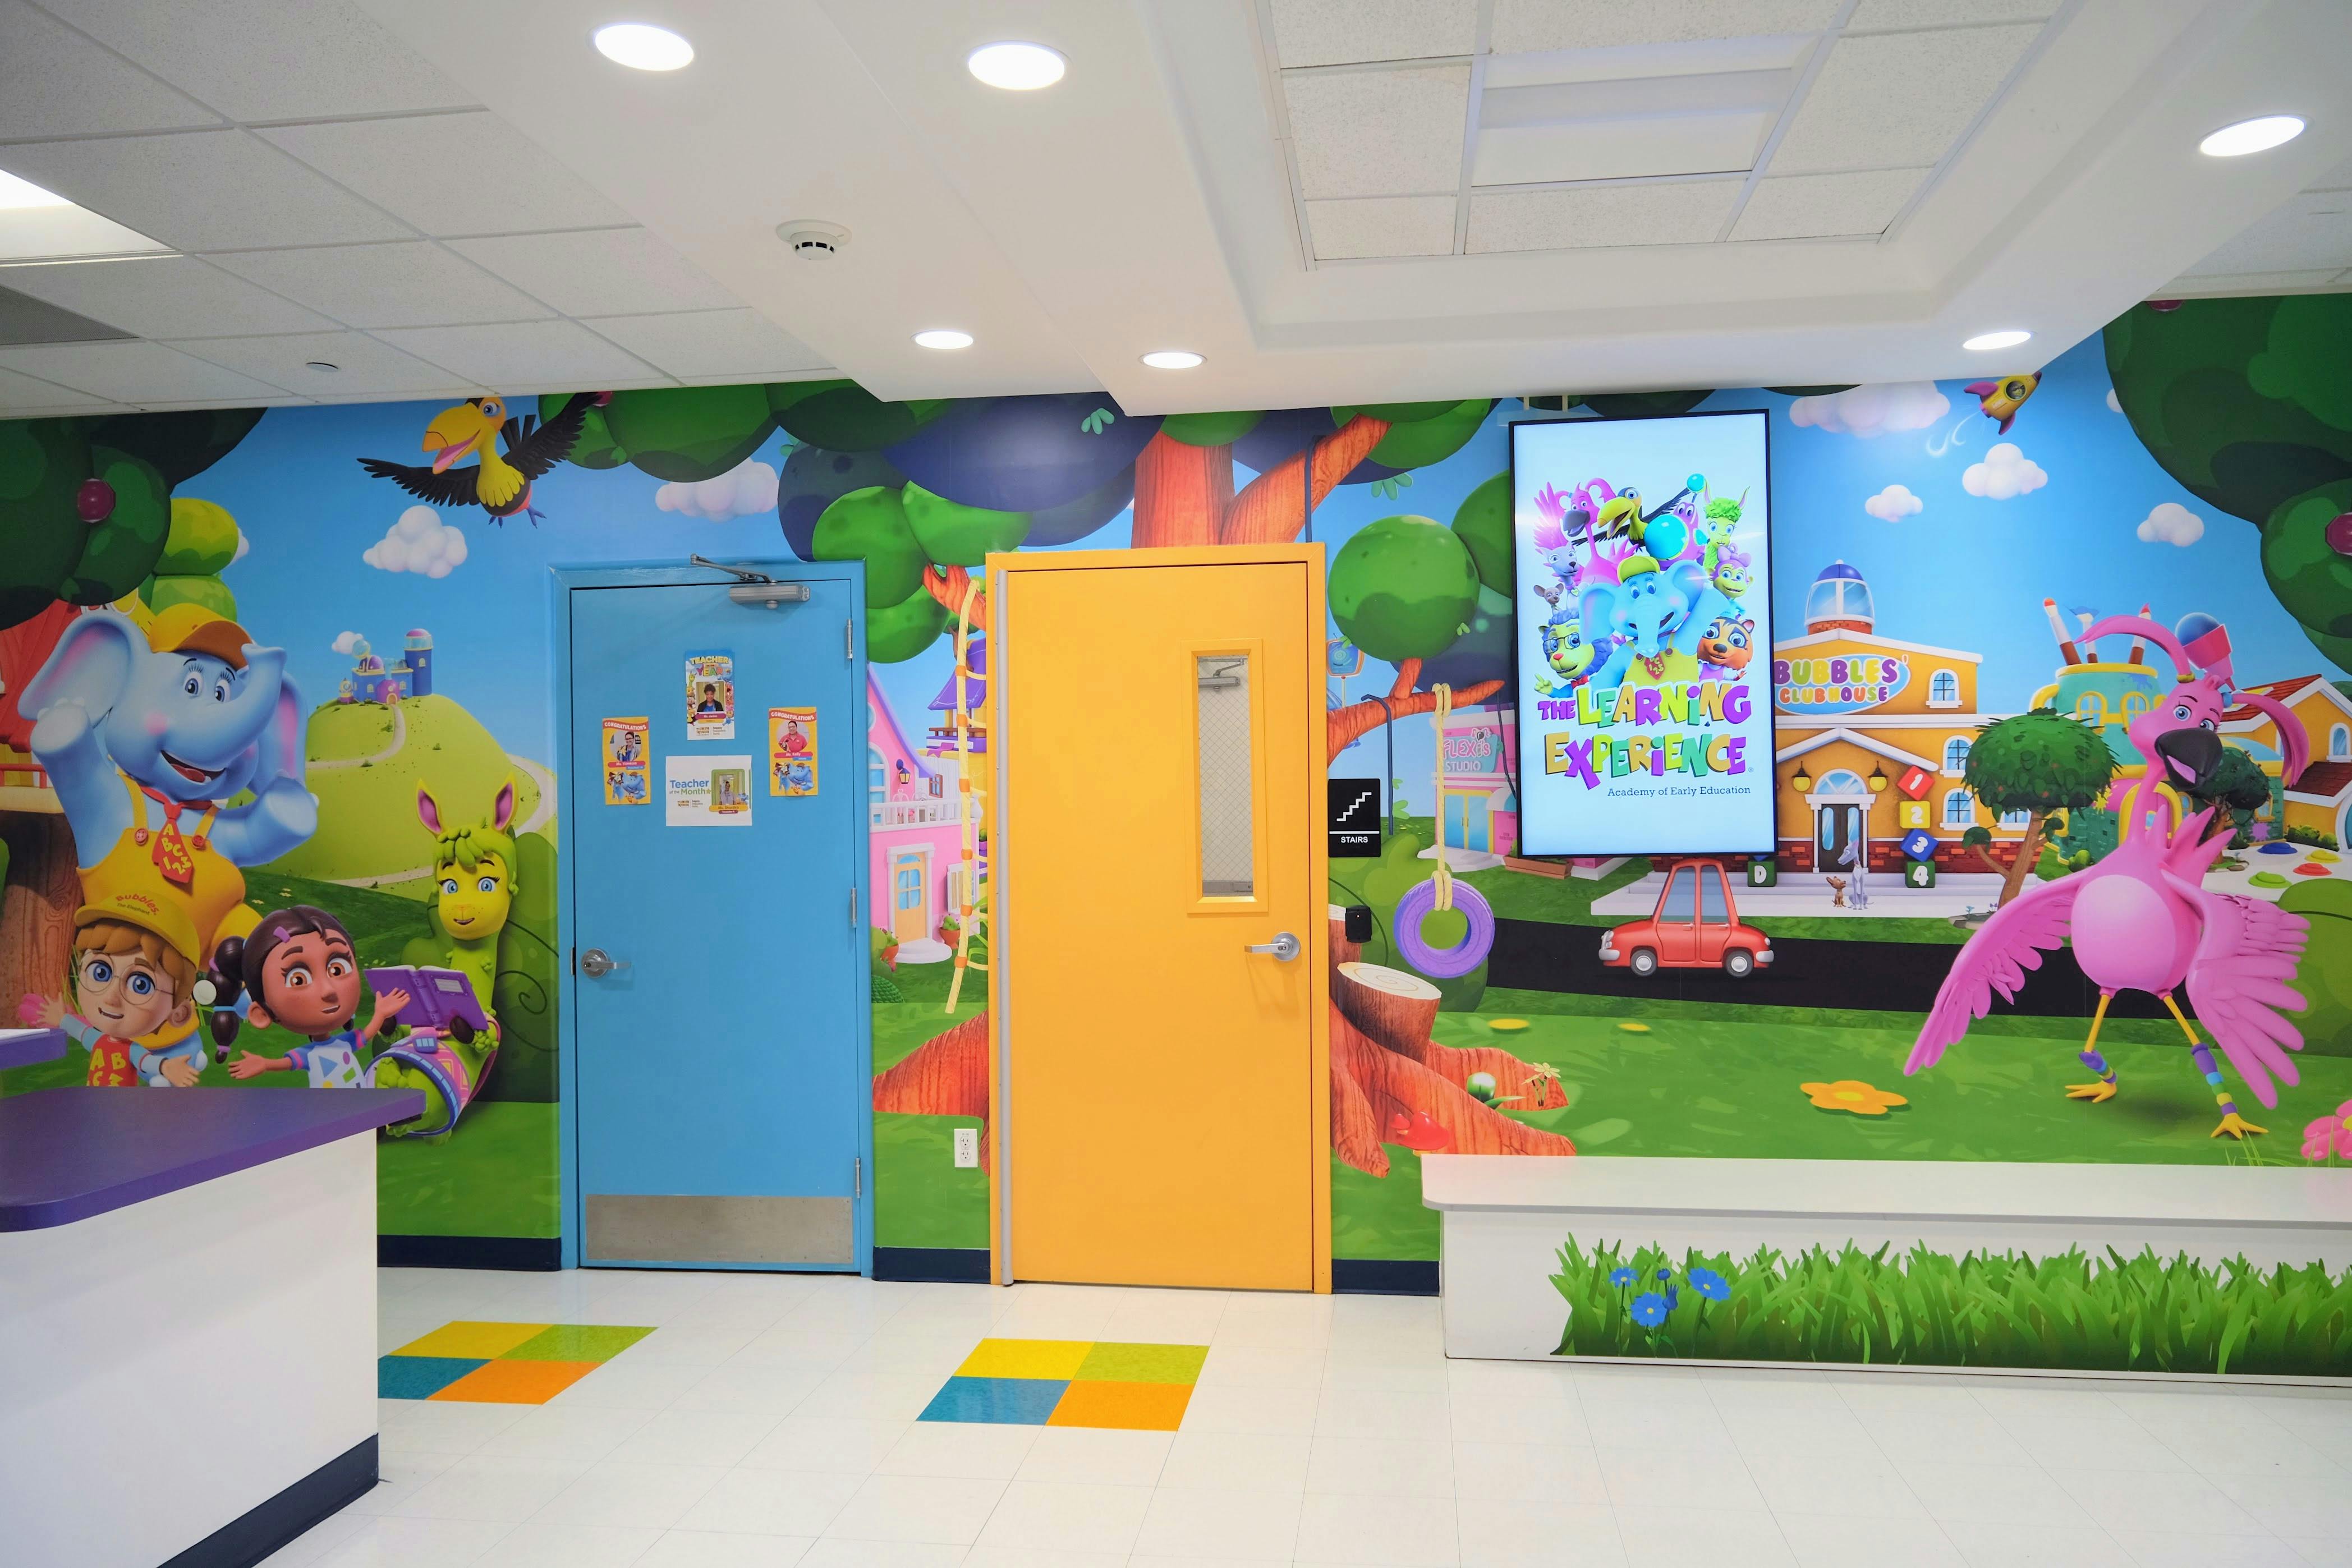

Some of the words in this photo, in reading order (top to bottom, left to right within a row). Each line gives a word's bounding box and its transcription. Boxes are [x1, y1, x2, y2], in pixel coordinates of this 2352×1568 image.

[691, 656, 729, 665] TEACHER
[696, 663, 724, 677] YEAR
[1779, 686, 1888, 703] CLUBHOUSE
[771, 712, 815, 721] CONGRATULATIONS
[1538, 700, 1575, 720] THE
[604, 722, 646, 730] CONGRATULATIONS
[1445, 761, 1482, 772] STUDIO
[669, 779, 710, 789] Teacher
[1910, 774, 1923, 790] 1
[1607, 788, 1653, 797] Academy
[1659, 787, 1669, 796] of
[1671, 787, 1697, 797] Early
[1700, 786, 1751, 795] Education
[1911, 806, 1923, 824] 2
[1912, 836, 1928, 853] 3
[1754, 865, 1767, 884] D
[1913, 866, 1929, 886] 4
[116, 893, 159, 913] Bubbles
[127, 904, 150, 916] Elephant
